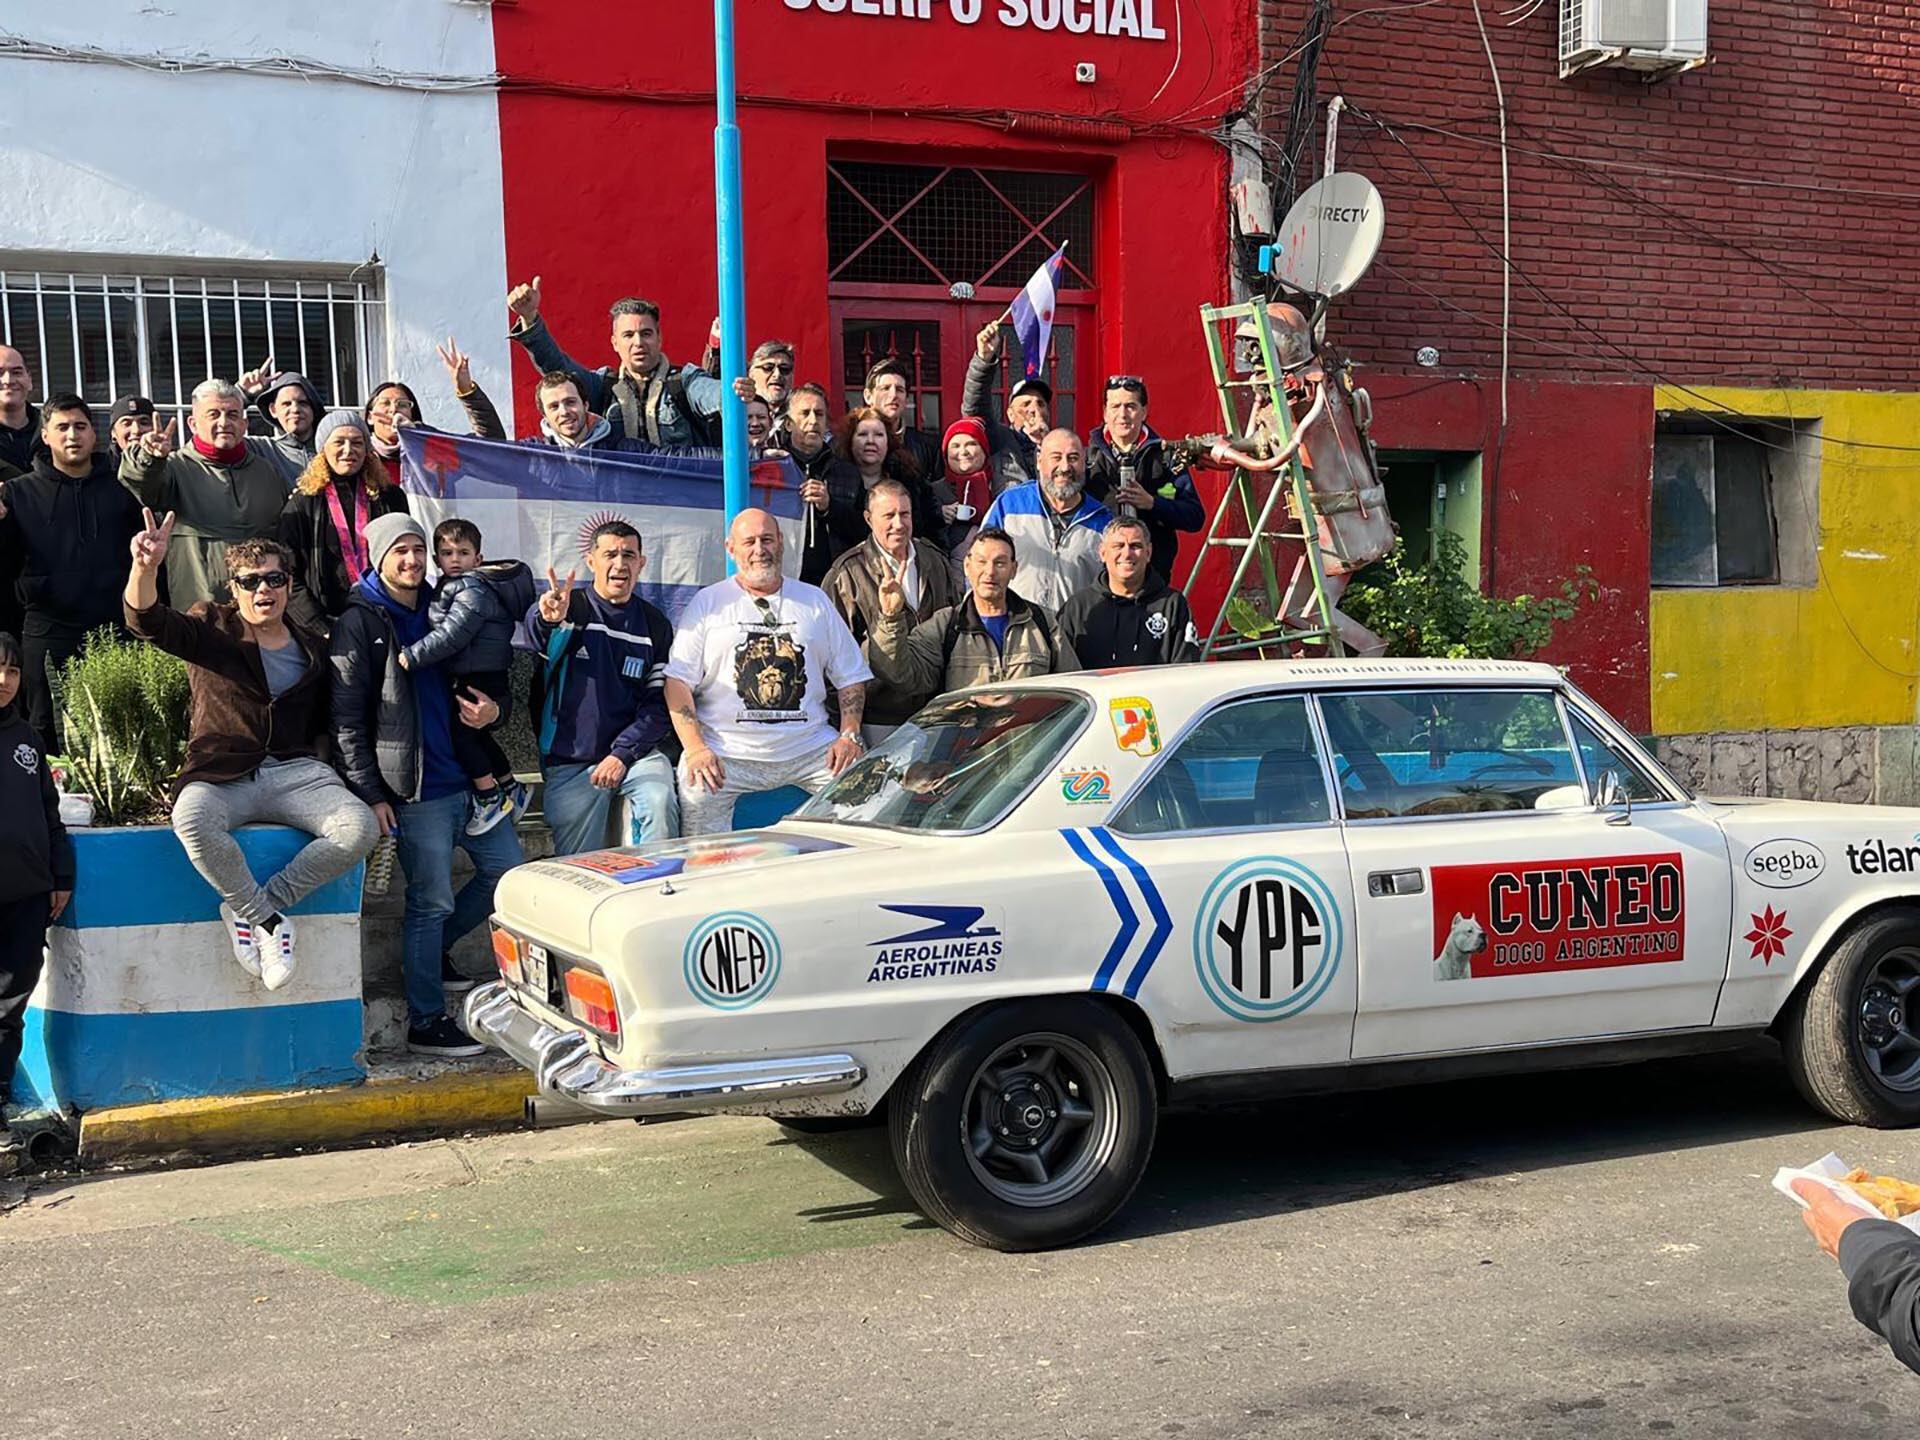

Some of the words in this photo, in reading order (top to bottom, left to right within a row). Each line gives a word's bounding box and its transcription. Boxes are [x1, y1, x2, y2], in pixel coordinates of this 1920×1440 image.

[998, 0, 1166, 40] SOCIAL
[1060, 765, 1107, 773] CANAL
[1753, 850, 1818, 880] segba
[1489, 862, 1681, 935] CUNEO
[875, 940, 1003, 965] AEROLINEAS
[1217, 879, 1321, 999] YPF
[1494, 941, 1545, 966] DOGO
[1555, 930, 1678, 961] ARGENTINO
[700, 927, 766, 994] CNEA
[867, 957, 997, 983] ARGENTINAS
